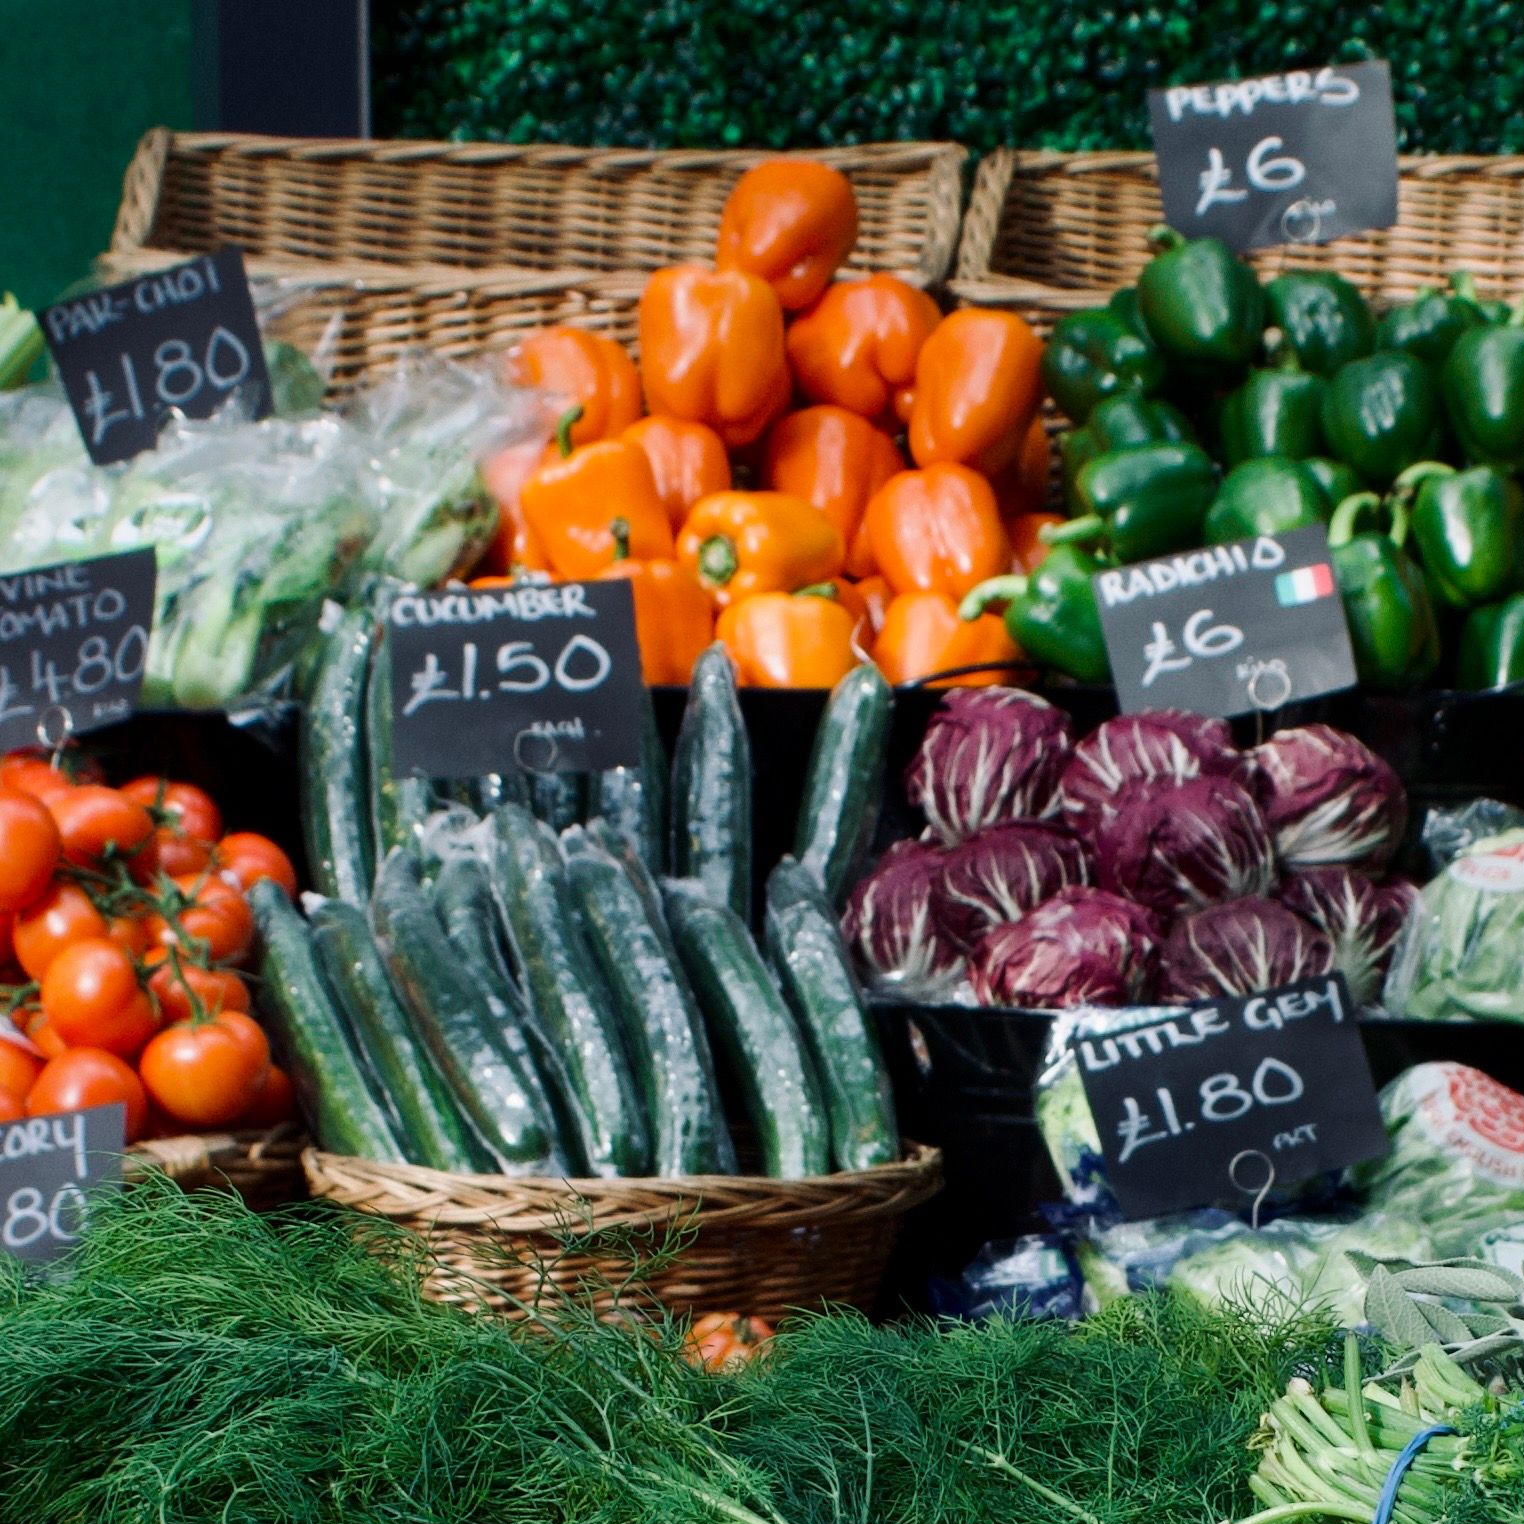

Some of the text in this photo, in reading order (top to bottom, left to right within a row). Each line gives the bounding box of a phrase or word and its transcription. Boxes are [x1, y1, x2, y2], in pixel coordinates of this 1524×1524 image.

[1165, 67, 1361, 122] PEPPERS
[1194, 136, 1307, 216] £6
[391, 583, 597, 626] CUCUMBER
[402, 633, 613, 717] £1.50
[1141, 608, 1245, 687] £6
[1080, 979, 1343, 1071] LITTLE GEM
[1115, 1056, 1304, 1164] £1.80
